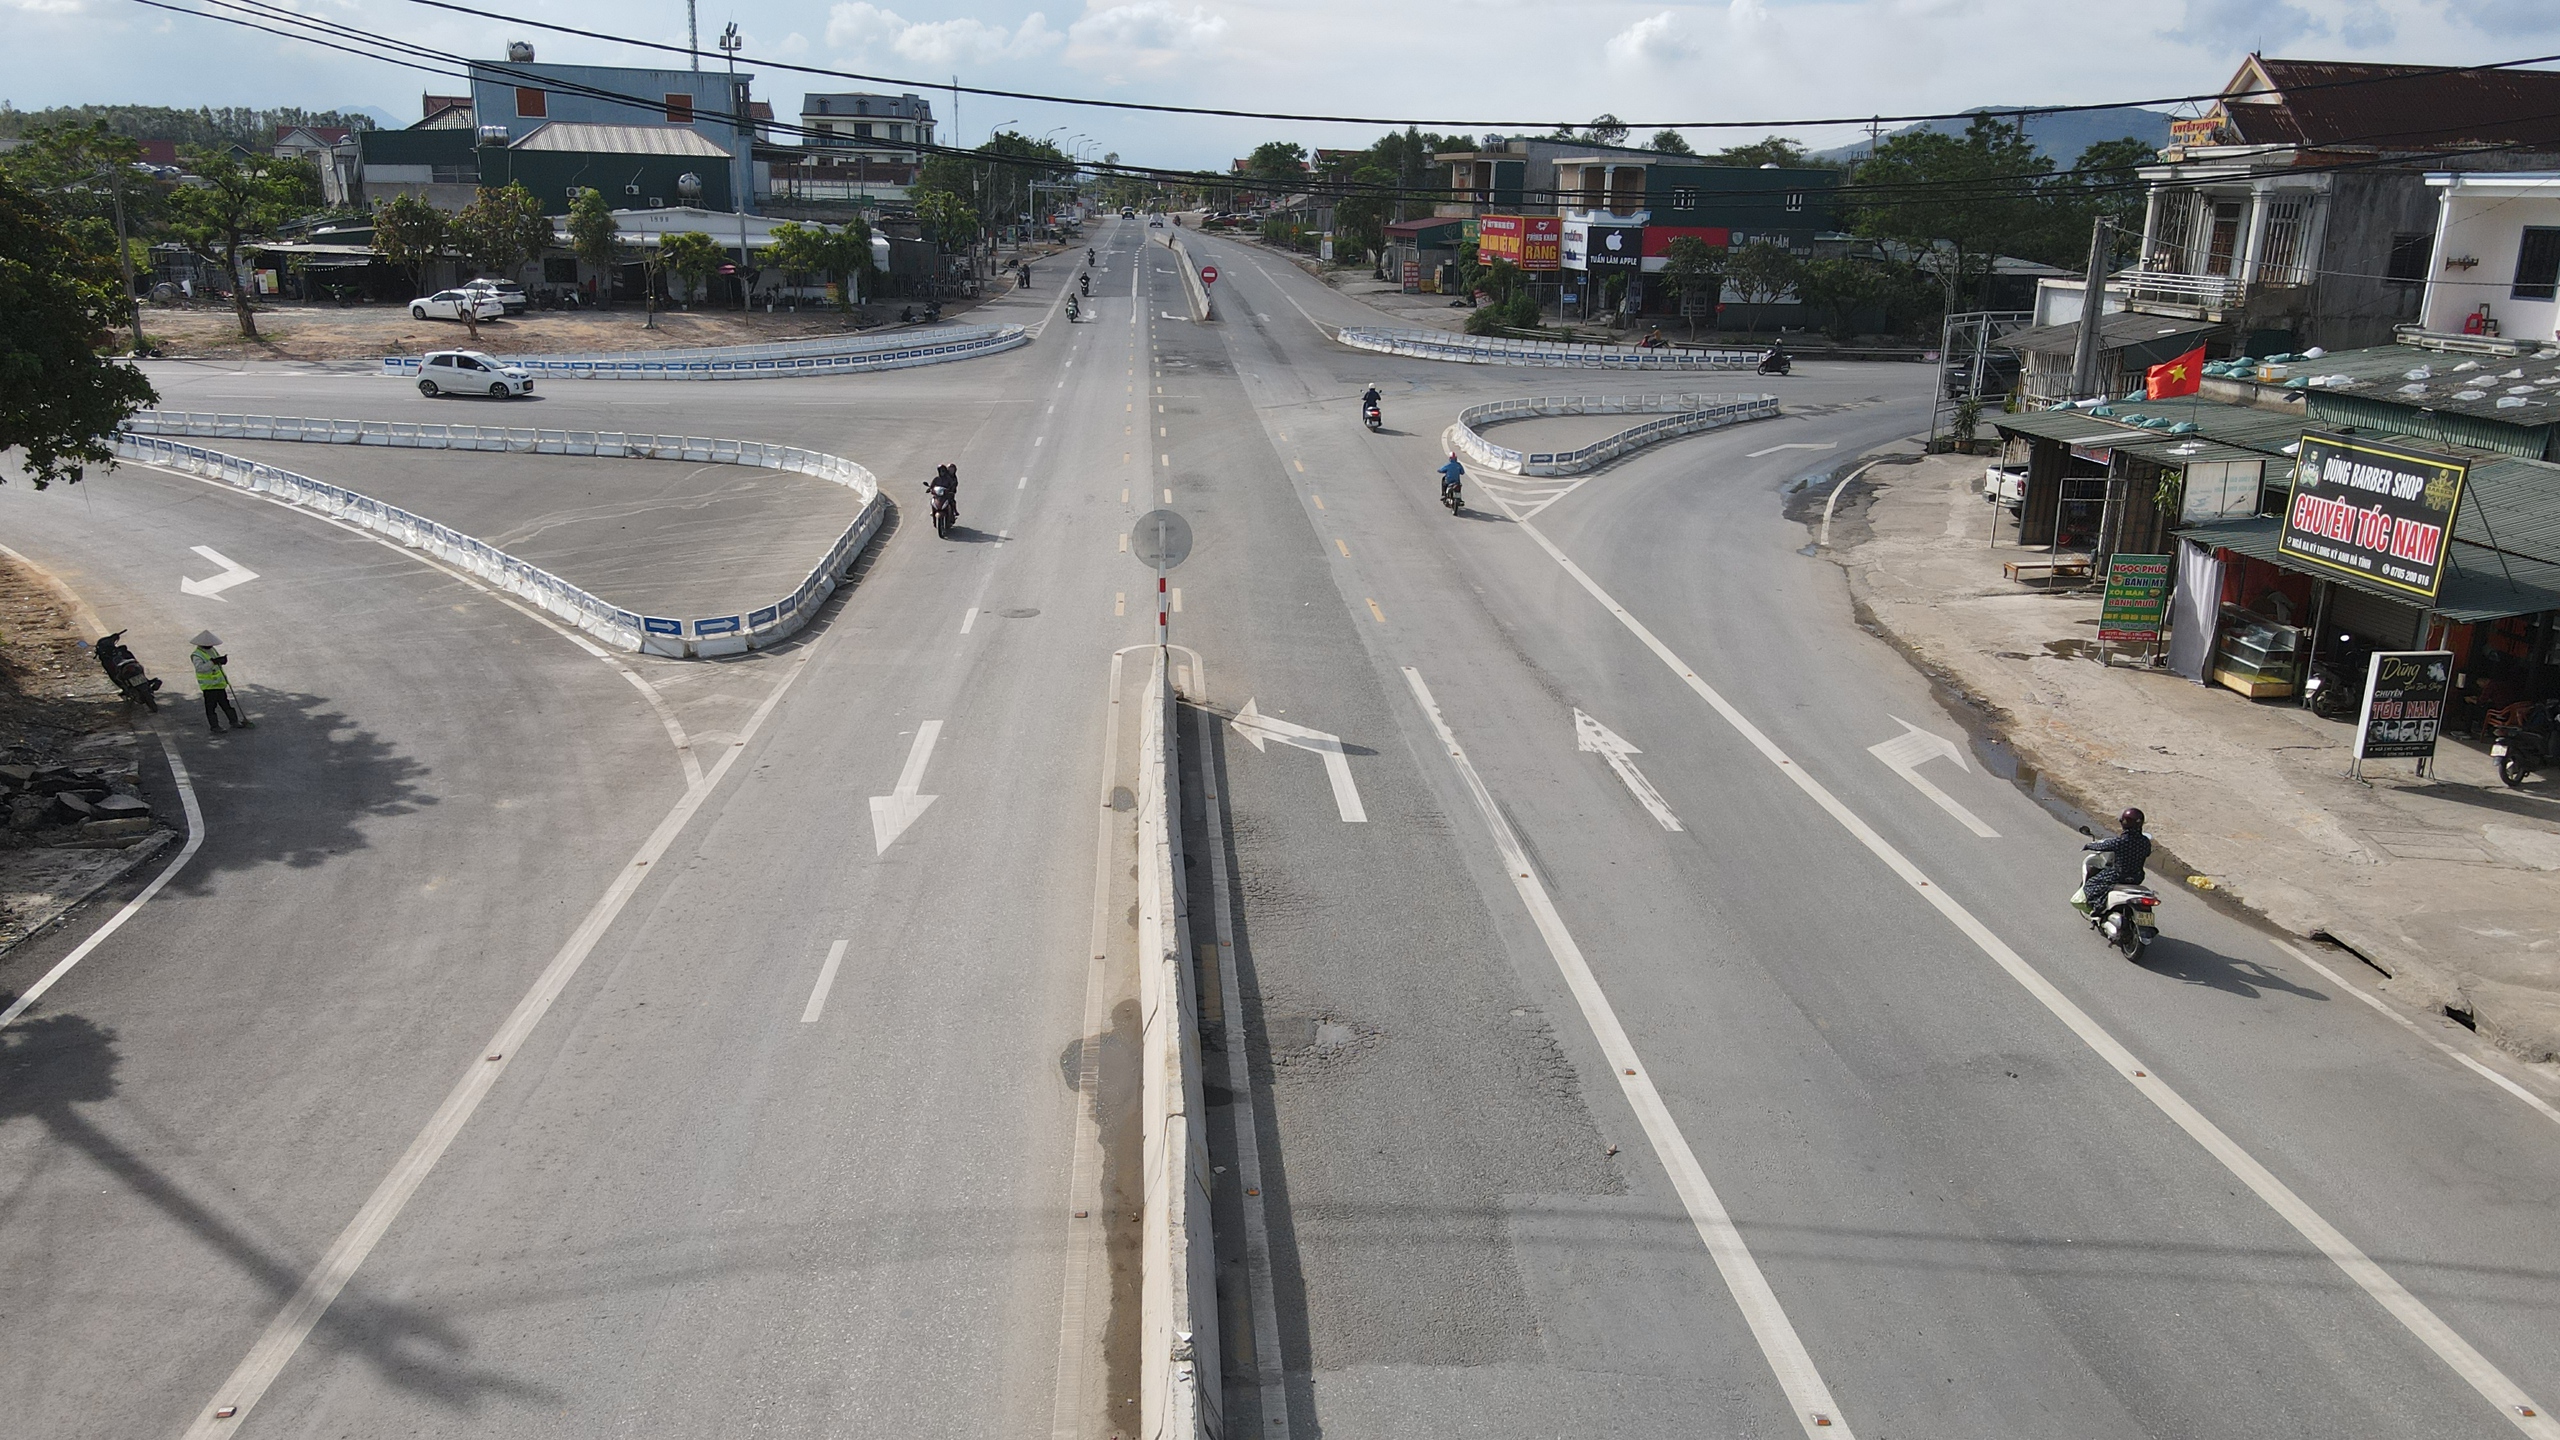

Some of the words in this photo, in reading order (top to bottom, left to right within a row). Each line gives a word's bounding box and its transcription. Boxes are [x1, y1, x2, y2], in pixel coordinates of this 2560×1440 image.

[1526, 242, 1557, 259] RĂNG
[1590, 253, 1606, 263] TUẤN
[1606, 254, 1618, 264] LÂM
[1619, 256, 1637, 266] APPLE
[2323, 454, 2352, 486] DŨNG
[2350, 463, 2392, 495] BARBER
[2392, 472, 2424, 501] SHOP
[2292, 493, 2357, 544] CHUYÊN
[2356, 504, 2391, 552] TÓC
[2390, 518, 2441, 566] NAM
[2112, 564, 2140, 575] NGỌC
[2141, 563, 2167, 574] PHÚC
[2124, 576, 2150, 587] BÁNH
[2109, 598, 2132, 606] BÁNH
[2381, 657, 2421, 685] Dũng
[2374, 689, 2404, 698] CHUYÊN
[2372, 698, 2403, 720] TÓC
[2405, 700, 2440, 719] NAM
